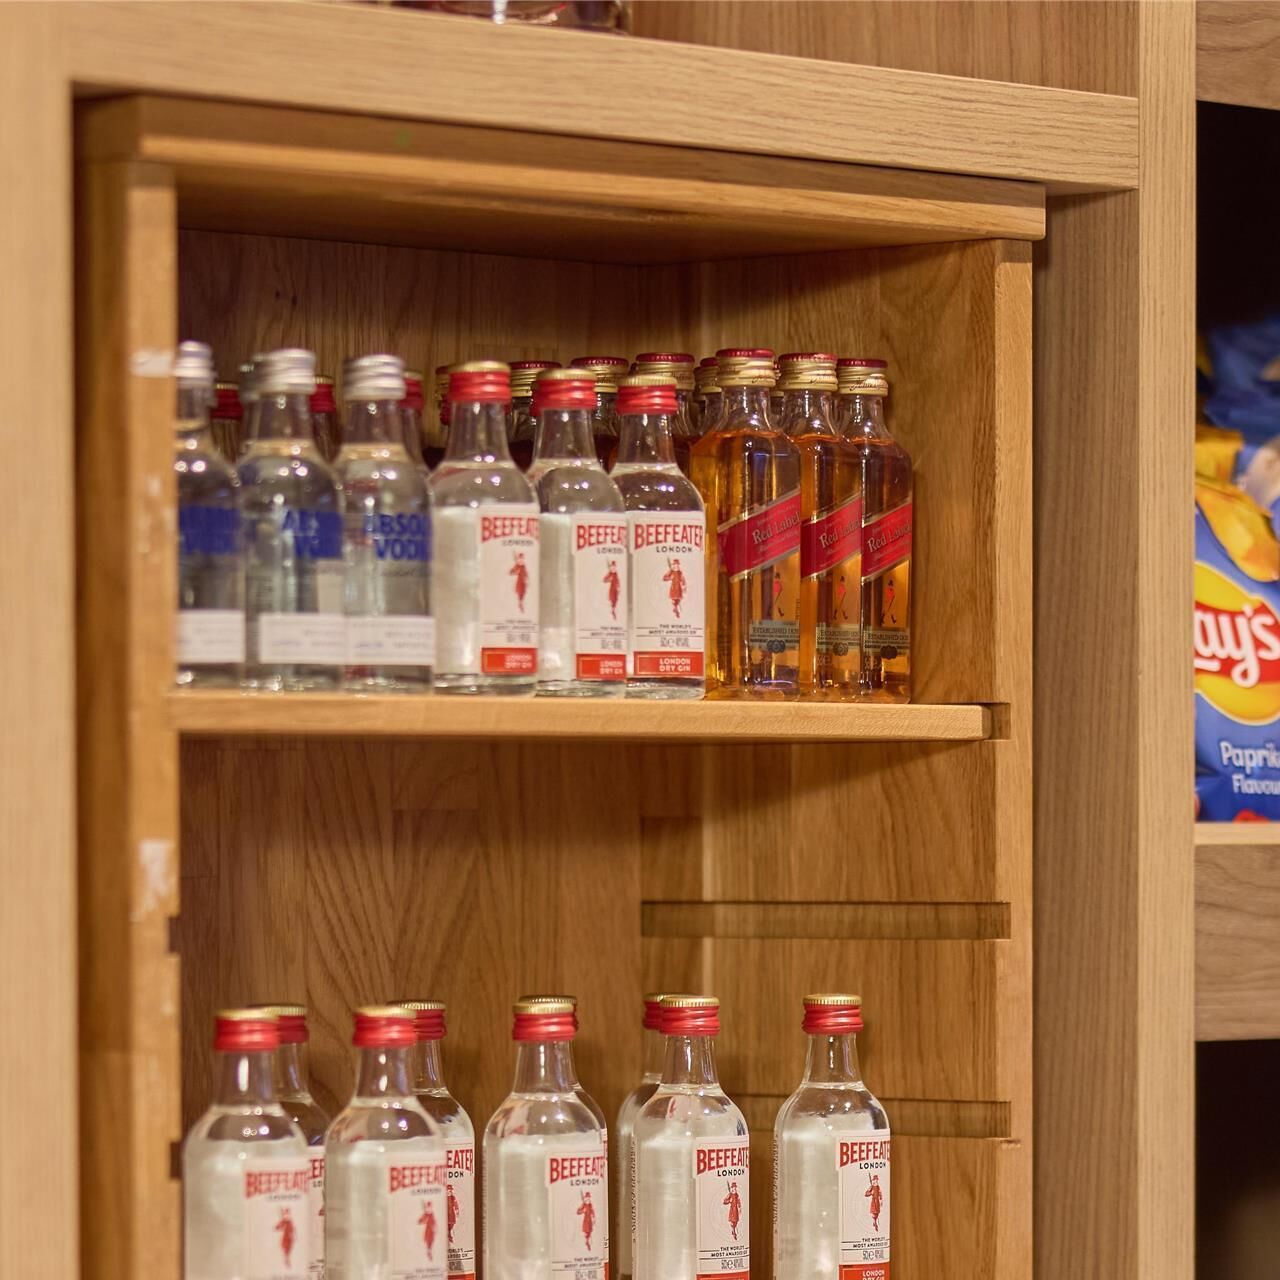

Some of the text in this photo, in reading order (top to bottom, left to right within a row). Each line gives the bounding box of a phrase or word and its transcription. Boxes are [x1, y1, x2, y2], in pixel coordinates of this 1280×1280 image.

[656, 545, 692, 553] LONDON
[859, 1161, 887, 1169] LONDON
[717, 1169, 745, 1177] LONDON
[570, 1179, 599, 1187] LONDON
